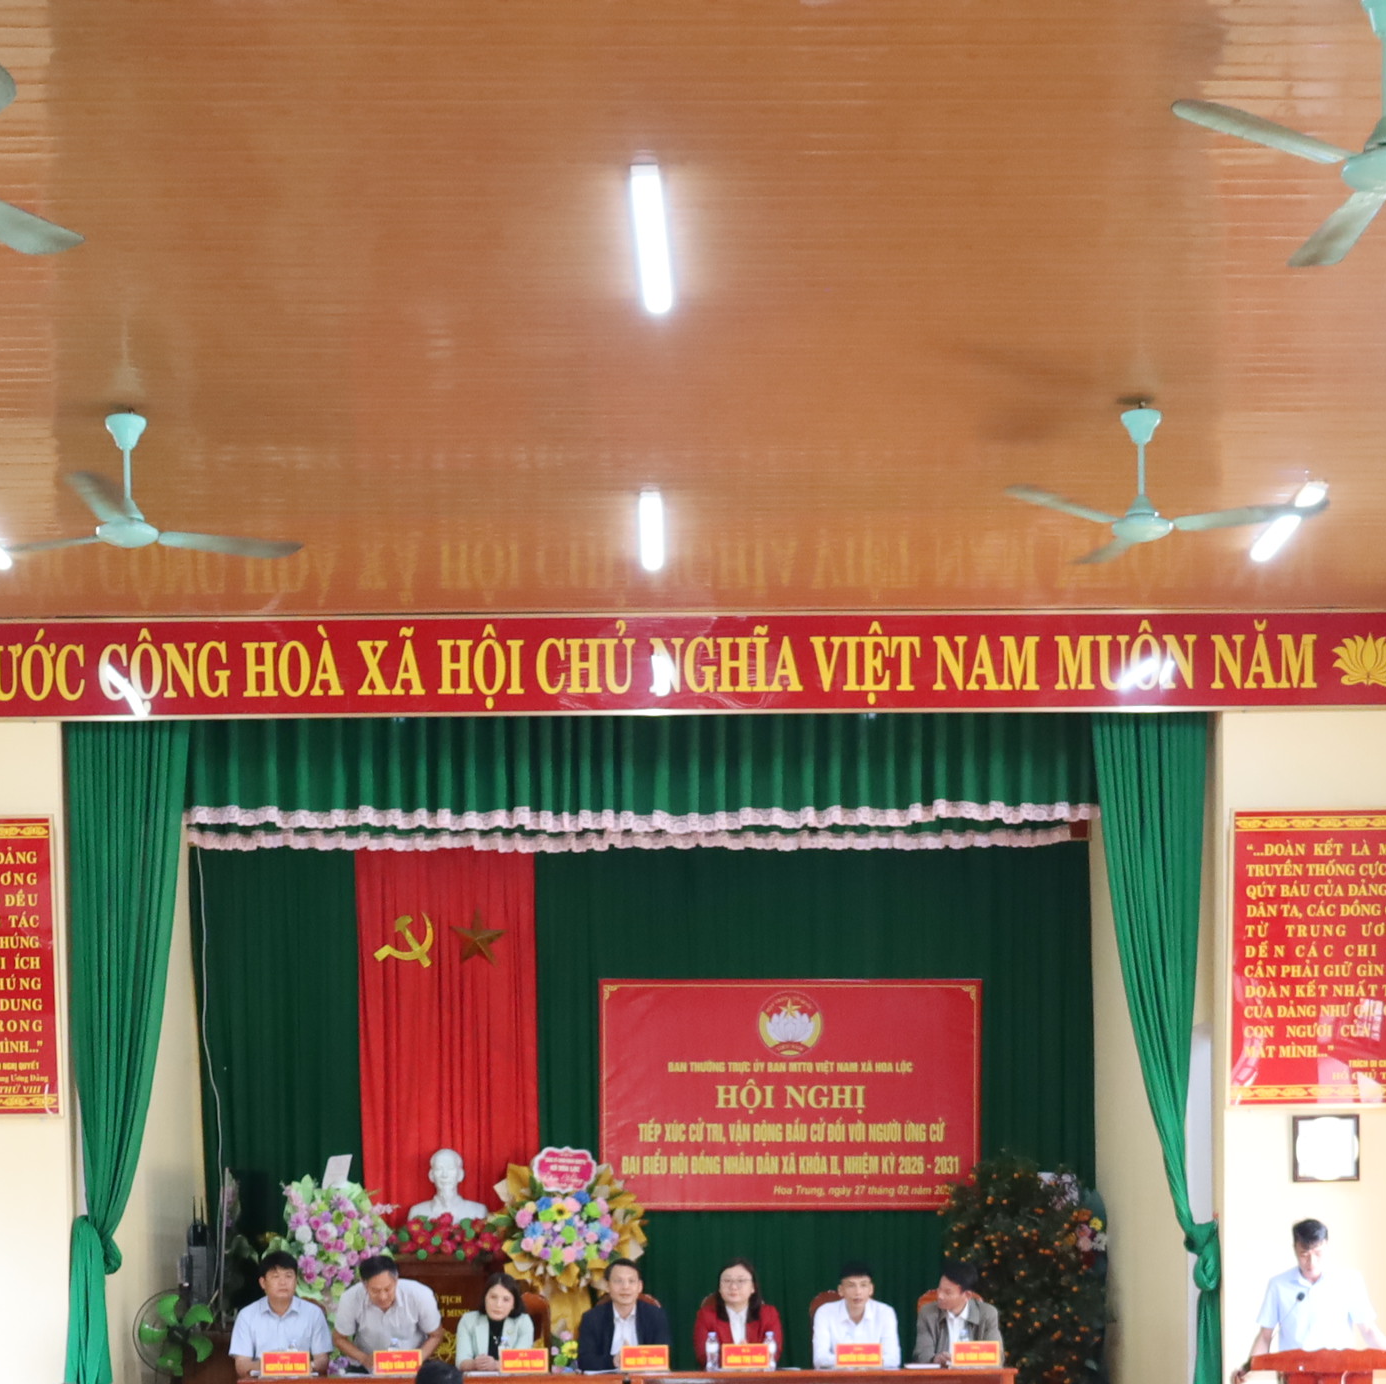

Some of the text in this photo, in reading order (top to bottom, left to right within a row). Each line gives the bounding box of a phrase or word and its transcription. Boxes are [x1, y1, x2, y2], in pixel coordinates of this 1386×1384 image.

[98, 628, 229, 716] CỘNG
[242, 625, 344, 698] HOÀ
[357, 626, 424, 697] XÃ
[437, 624, 524, 711] HỘI
[536, 619, 636, 693] CHỦ
[650, 624, 802, 692] NGHĨA
[810, 621, 920, 704] VIỆT
[933, 635, 1040, 691] NAM
[1054, 619, 1195, 691] MUÔN
[1211, 618, 1318, 690] NĂM
[1313, 839, 1343, 855] KẾT
[1351, 840, 1370, 855] LÀ
[1246, 860, 1303, 876] TRUYỀN
[1306, 860, 1355, 876] THỐNG
[1359, 861, 1386, 879] CỰC
[1280, 880, 1310, 896] BÁU
[1313, 880, 1343, 896] CỦA
[5, 890, 37, 906] ĐỀU
[1247, 902, 1277, 917] DÂN
[1280, 904, 1302, 918] TA,
[1306, 901, 1335, 916] CÁC
[1340, 900, 1381, 916] ĐỒNG
[8, 911, 39, 927] TÁC
[1245, 921, 1268, 937] TỪ
[1285, 924, 1346, 936] TRUNG
[1245, 941, 1284, 957] ĐẾN
[1295, 942, 1333, 958] CÁC
[1344, 944, 1376, 956] CHI
[15, 953, 39, 968] ÍCH
[1244, 961, 1276, 978] CẦN
[1281, 960, 1319, 978] PHẢI
[1323, 961, 1351, 976] GIỮ
[1356, 961, 1383, 976] GÌN
[1244, 982, 1290, 998] ĐOÀN
[1295, 980, 1328, 996] KẾT
[1332, 981, 1377, 997] NHẤT
[0, 999, 42, 1010] DUNG
[1277, 1001, 1316, 1018] ĐẢNG
[1320, 1002, 1351, 1017] NHƯ
[1244, 1026, 1274, 1038] CON
[836, 1062, 858, 1072] NAM
[715, 1078, 866, 1115] HỘI NGHỊ
[638, 1118, 662, 1142] TIẾP
[664, 1120, 686, 1142] XÚC
[688, 1117, 705, 1142] CỬ
[729, 1119, 751, 1146] VẬN
[753, 1119, 783, 1146] ĐỘNG
[810, 1117, 826, 1142] CỬ
[827, 1117, 846, 1142] ĐỐI
[929, 1116, 945, 1142] CỬ
[621, 1156, 641, 1179] ĐẠI
[643, 1148, 668, 1174] BIỂU
[670, 1152, 688, 1179] HỘI
[723, 1152, 754, 1174] NHÂN
[756, 1152, 779, 1174] DÂN
[782, 1152, 796, 1174] XÃ
[799, 1152, 827, 1174] KHÓA
[844, 1152, 879, 1179] NHIỆM
[881, 1152, 896, 1174] KỲ
[898, 1156, 924, 1174] 2026
[934, 1156, 959, 1174] 2031
[773, 1185, 932, 1197] Hoa Trung, ngày 27 tháng 02 năm
